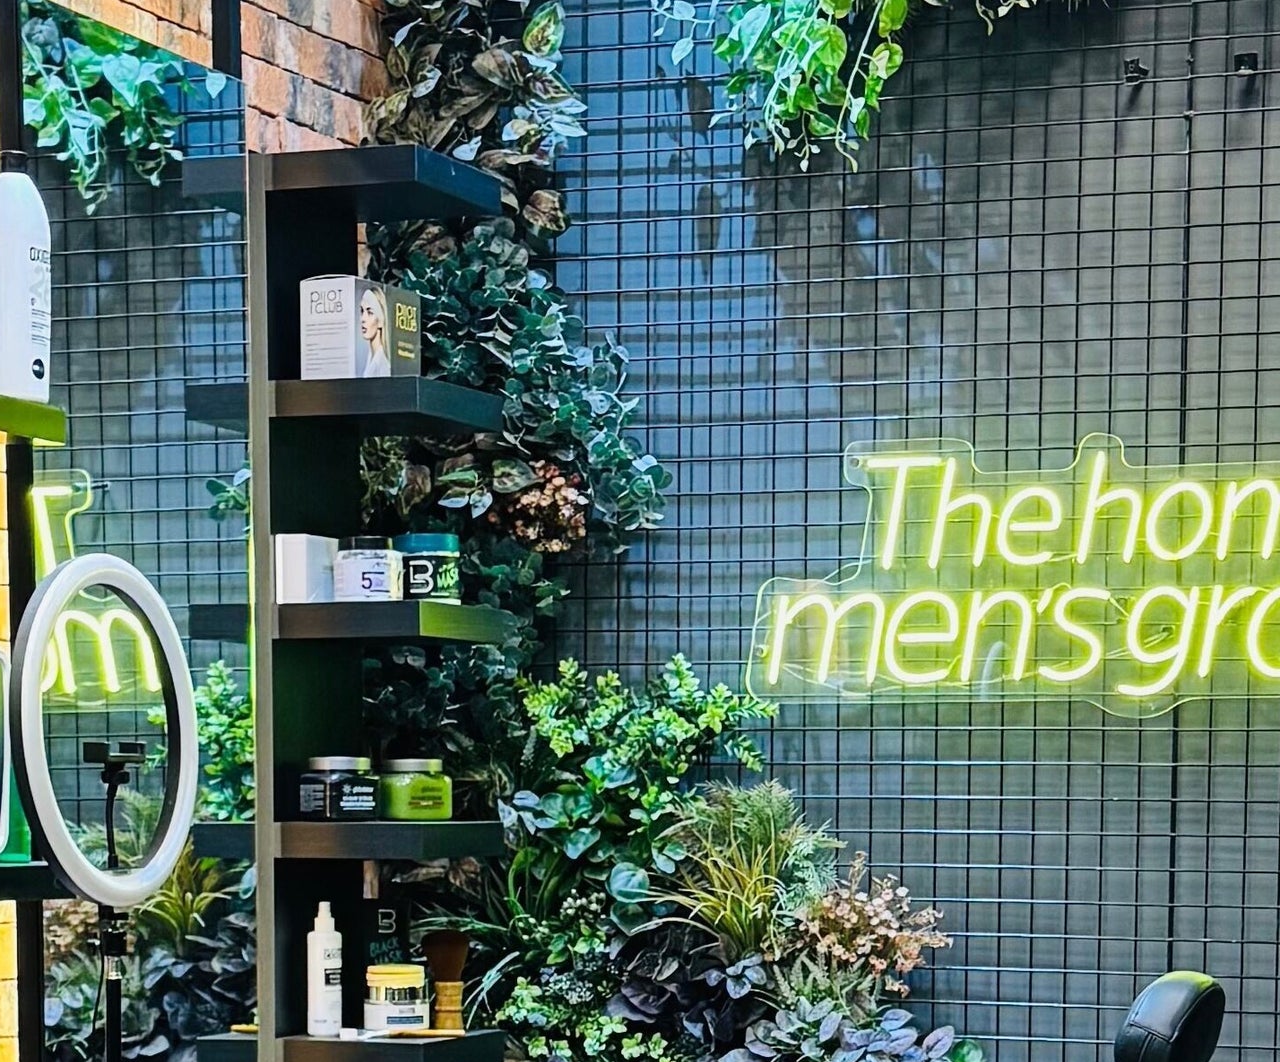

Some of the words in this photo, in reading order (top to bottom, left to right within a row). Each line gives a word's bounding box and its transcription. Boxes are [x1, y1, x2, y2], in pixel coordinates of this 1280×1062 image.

[866, 456, 1062, 570] The
[768, 589, 1111, 685] men's
[370, 936, 400, 958] BLACK
